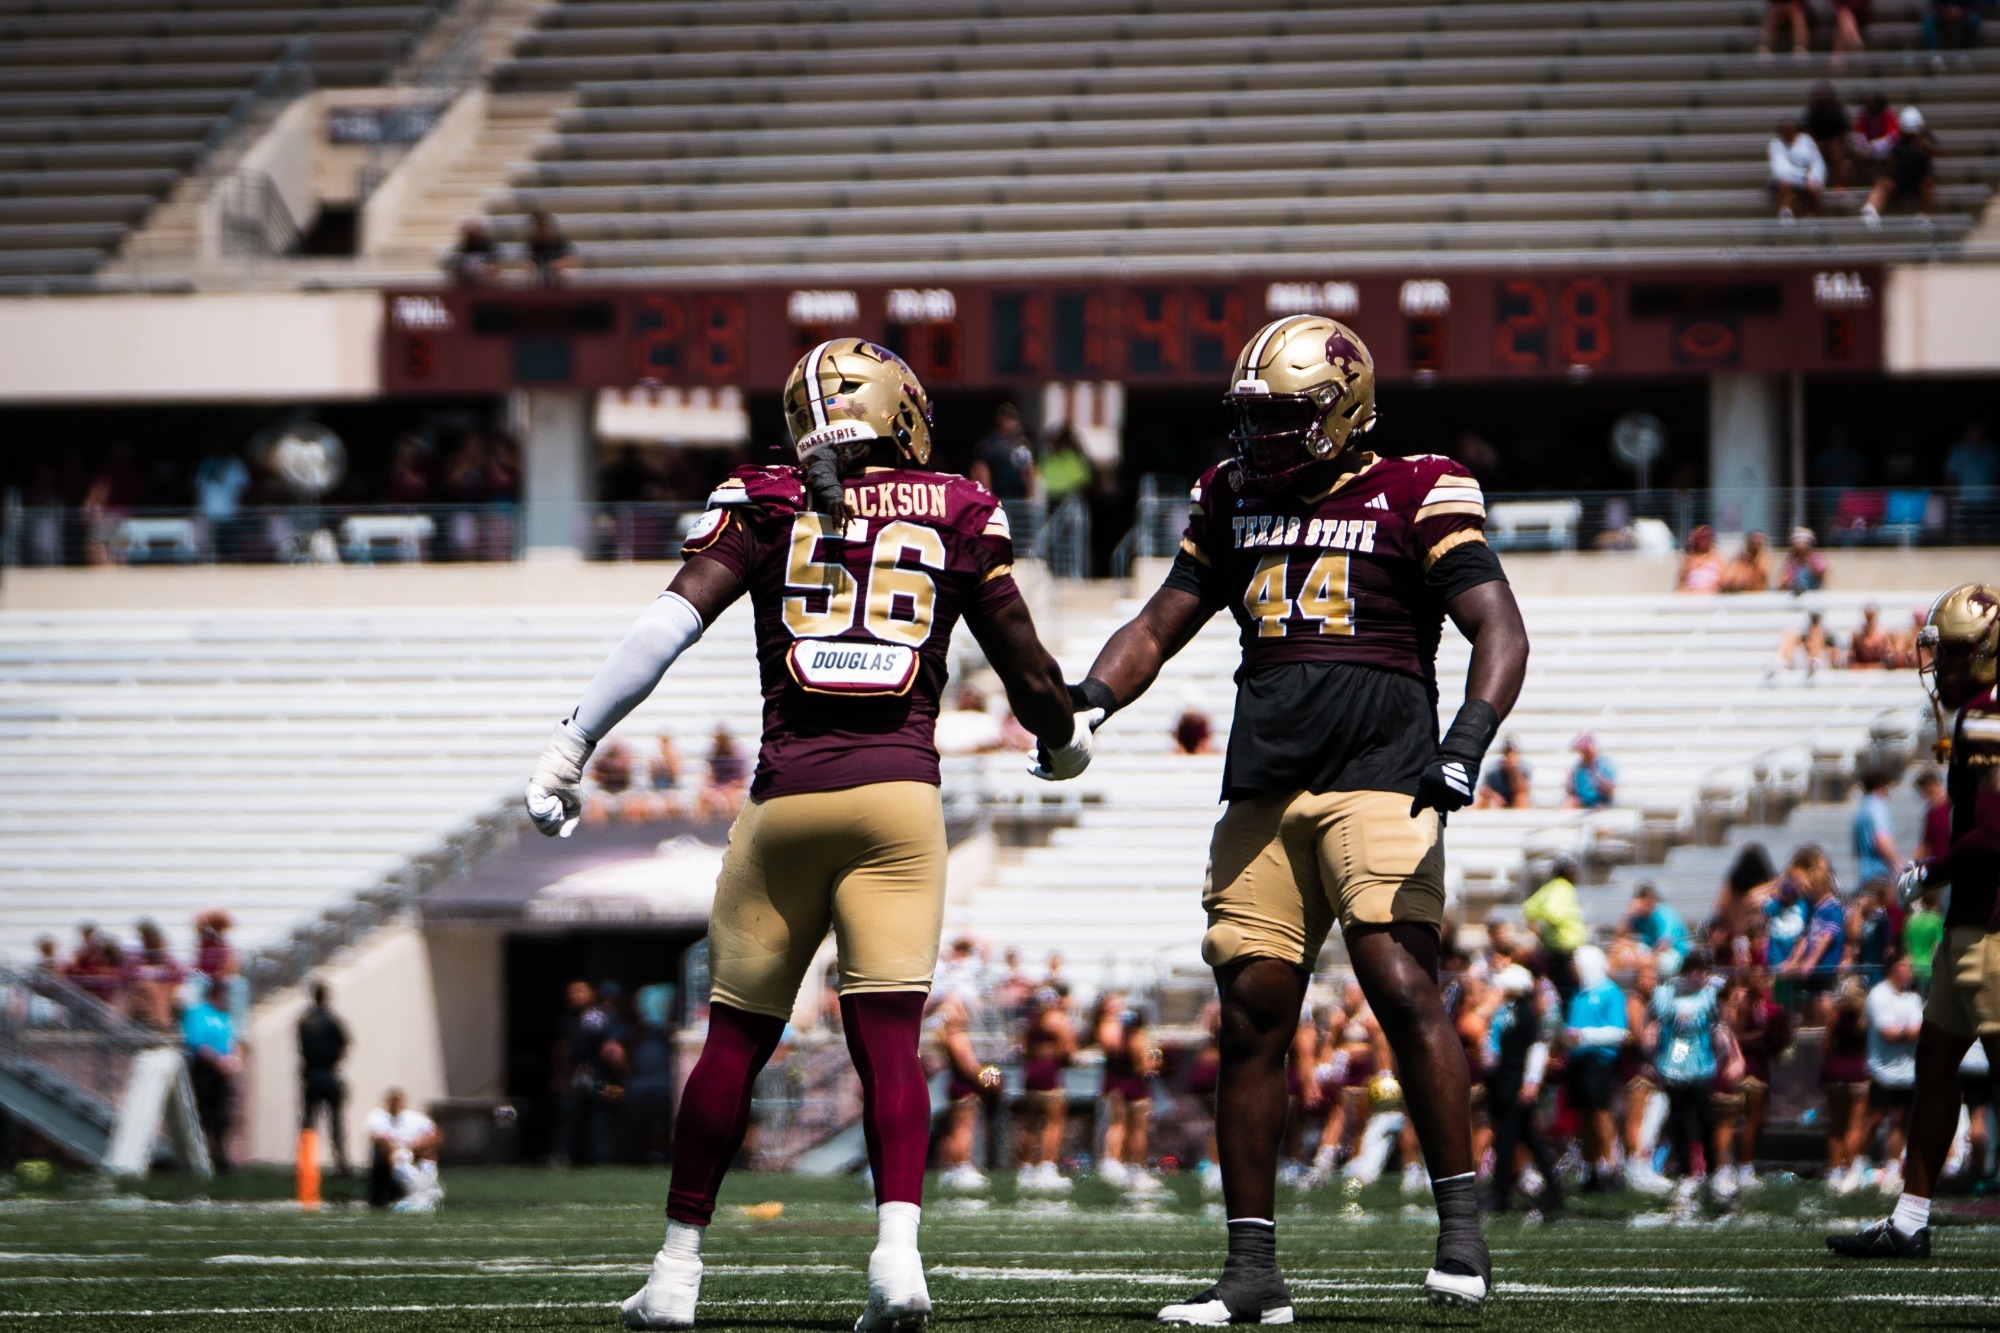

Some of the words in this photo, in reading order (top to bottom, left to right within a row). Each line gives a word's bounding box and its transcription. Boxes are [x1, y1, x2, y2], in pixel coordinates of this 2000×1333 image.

[630, 295, 746, 379] 28
[1500, 280, 1611, 365] 28
[798, 434, 824, 453] TEXAS
[824, 427, 857, 441] STATE
[843, 482, 947, 518] ACKSON
[1232, 516, 1300, 548] TEXAS
[1304, 518, 1377, 553] STATE
[782, 512, 946, 647] 56
[1244, 551, 1355, 637] 44
[811, 651, 897, 671] DOUGLAS
